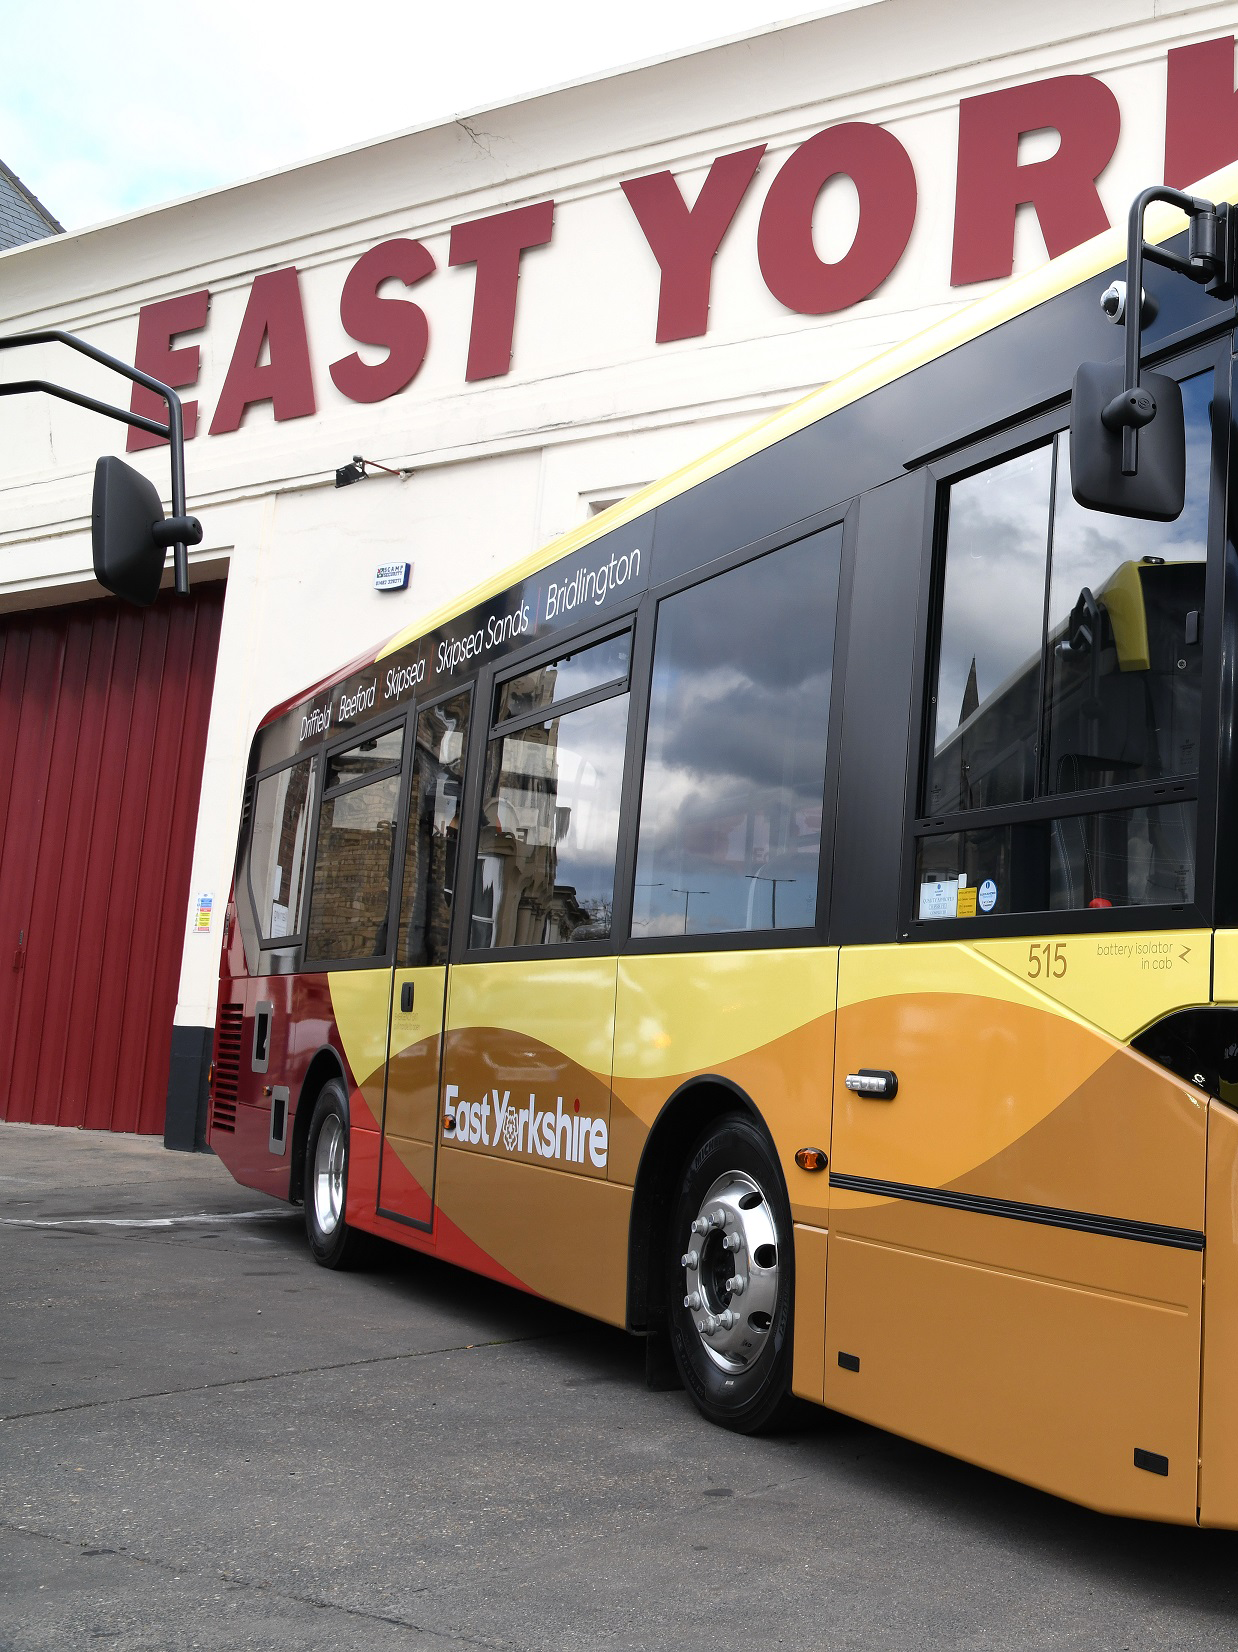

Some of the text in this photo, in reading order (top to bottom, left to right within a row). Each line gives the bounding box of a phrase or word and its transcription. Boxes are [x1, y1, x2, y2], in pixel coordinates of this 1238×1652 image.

[126, 199, 555, 453] EAST
[300, 548, 641, 741] Driffield Beeford Skipsea Skipsea Sands Bridlington
[1027, 943, 1067, 978] 515
[1097, 941, 1173, 958] battery isolator
[1141, 957, 1173, 970] in cab
[443, 1084, 608, 1168] East Yorkshire
